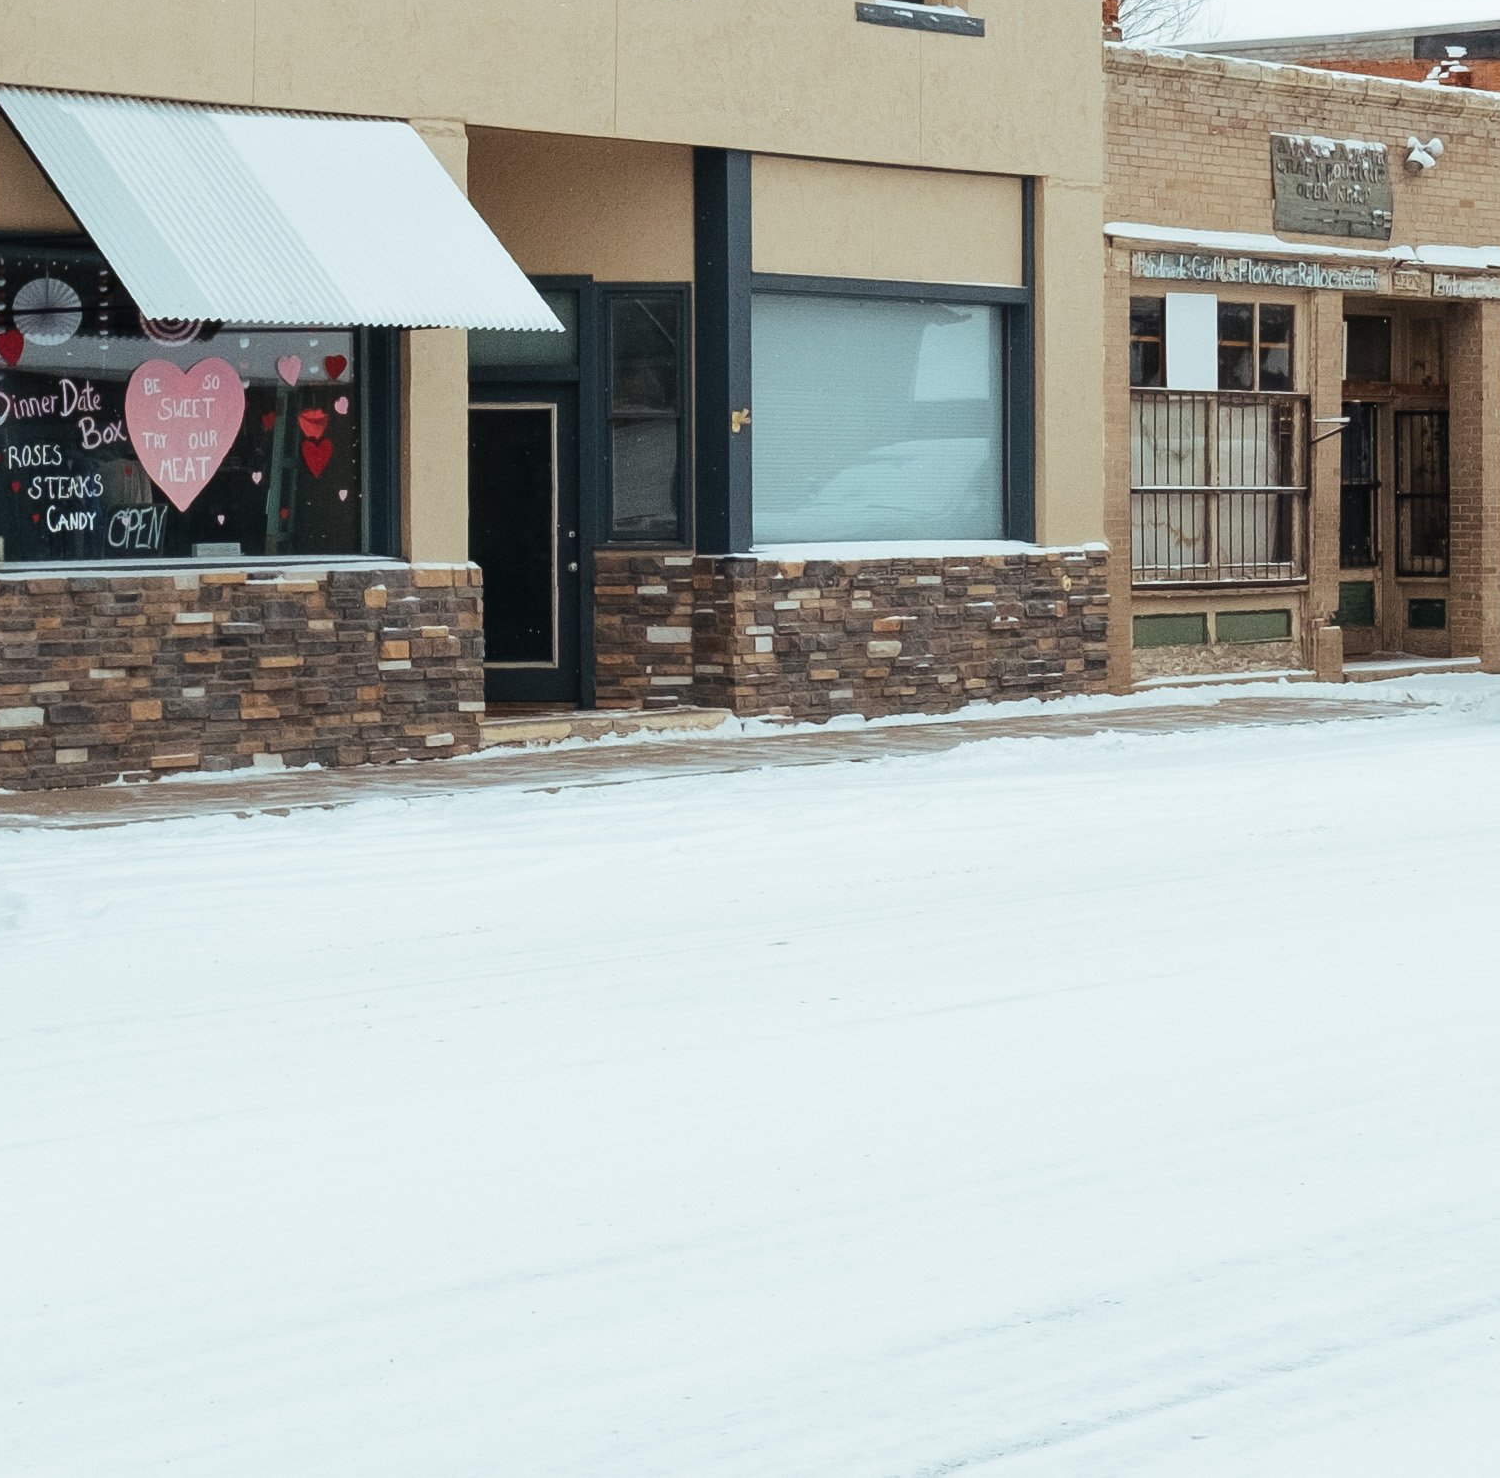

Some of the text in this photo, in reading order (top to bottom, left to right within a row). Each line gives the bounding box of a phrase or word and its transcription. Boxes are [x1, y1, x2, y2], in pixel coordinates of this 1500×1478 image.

[59, 378, 102, 417] Date
[143, 374, 220, 396] BE SO
[157, 397, 216, 421] SWEET
[142, 430, 218, 450] TRY OUR
[8, 444, 62, 470] ROSES
[159, 456, 212, 483] MEAT
[27, 474, 104, 500] STEAKS
[108, 505, 168, 550] OPEN
